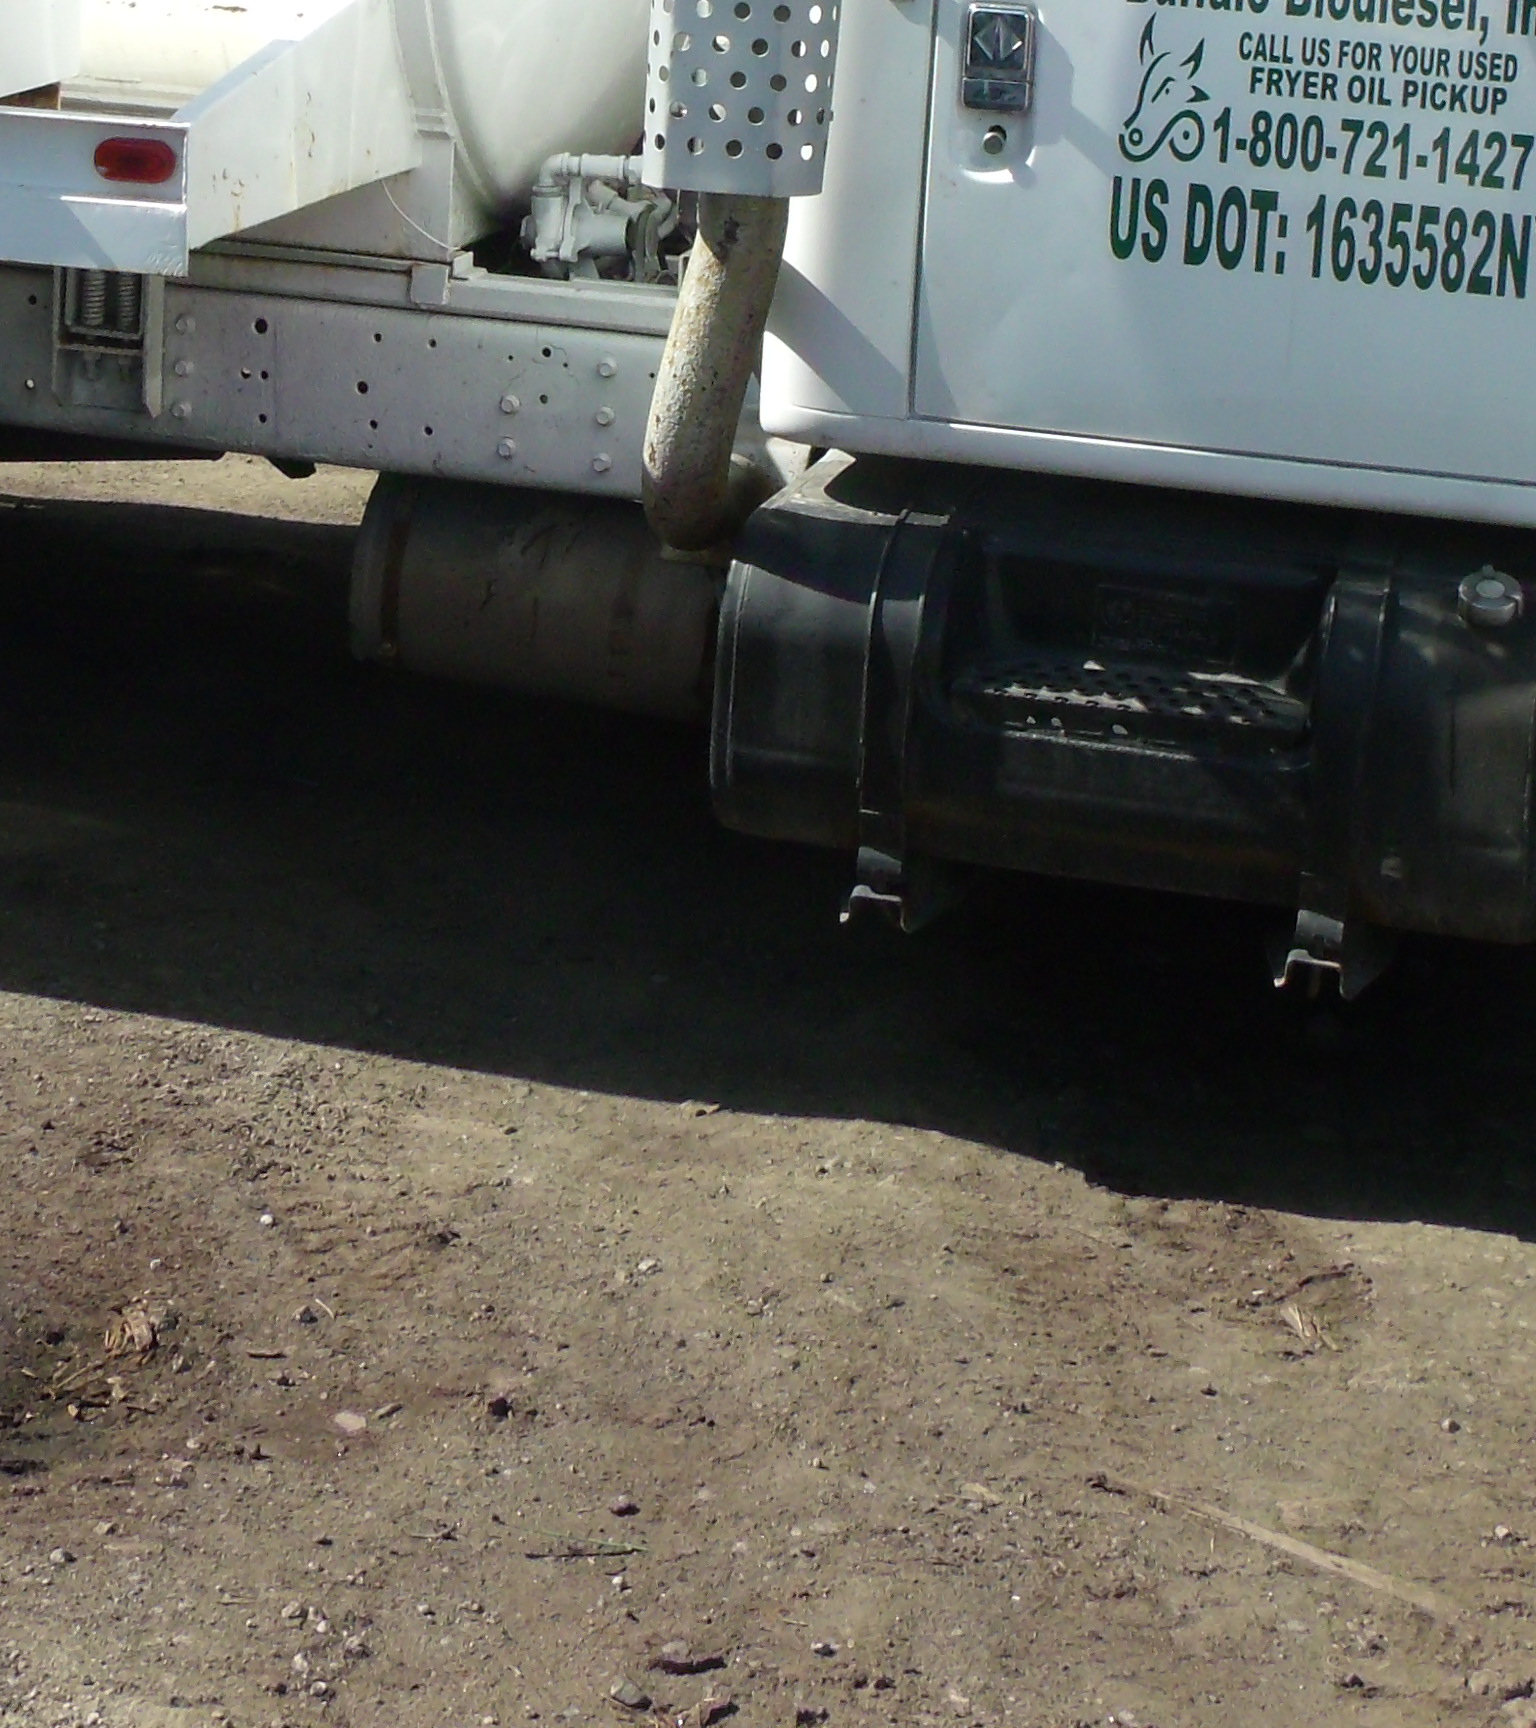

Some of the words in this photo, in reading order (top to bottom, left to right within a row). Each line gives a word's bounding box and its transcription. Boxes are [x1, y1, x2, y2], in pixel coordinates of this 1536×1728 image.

[1238, 31, 1294, 65] CALL
[1301, 36, 1331, 68] US
[1337, 40, 1382, 72] FOR
[1390, 44, 1451, 78] YOUR
[1458, 49, 1519, 83] USED
[1249, 66, 1338, 102] FRYER
[1347, 75, 1392, 107] OIL
[1401, 79, 1508, 116] PICKUP
[1212, 106, 1535, 191] 1-800-721-1427
[1109, 175, 1170, 263] US
[1183, 181, 1289, 275] DOT:
